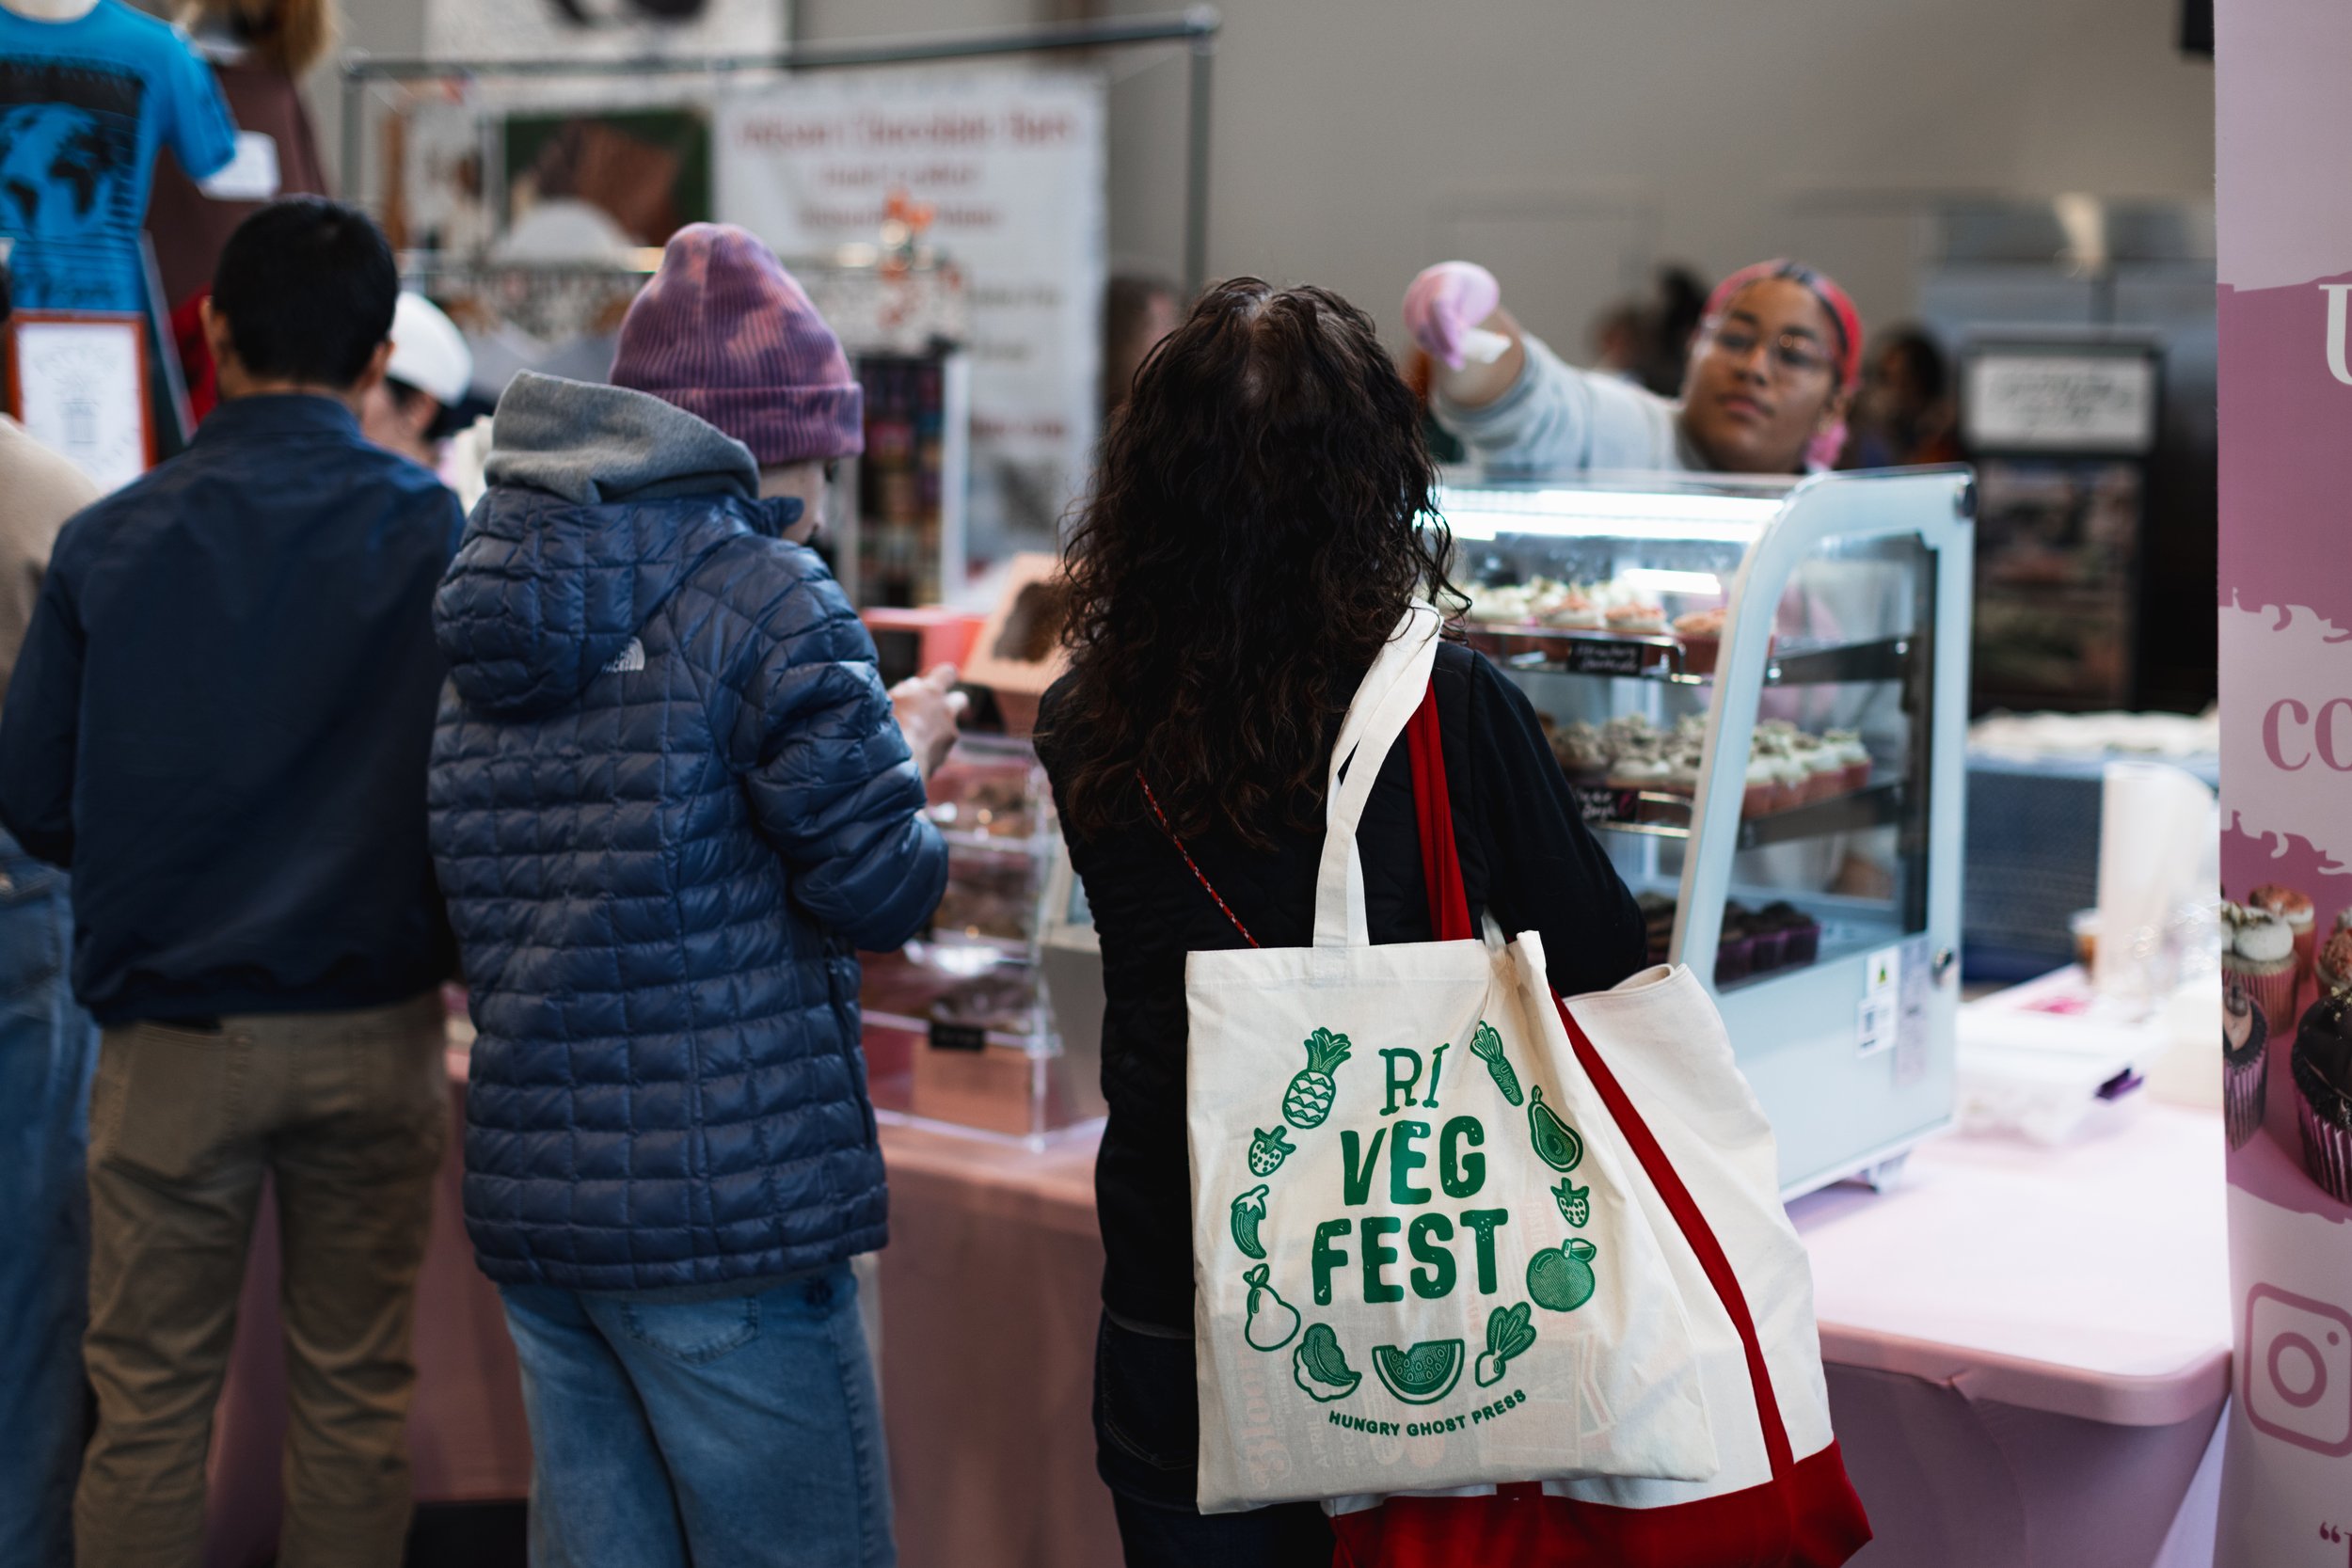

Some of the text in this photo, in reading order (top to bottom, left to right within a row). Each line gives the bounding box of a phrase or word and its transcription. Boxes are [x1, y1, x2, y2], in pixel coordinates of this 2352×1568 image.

[1377, 1042, 1451, 1117] RI
[1340, 1116, 1486, 1207] VEG
[1311, 1208, 1509, 1307] FEST
[1328, 1388, 1526, 1436] HUNGRY GHOST PRESS
